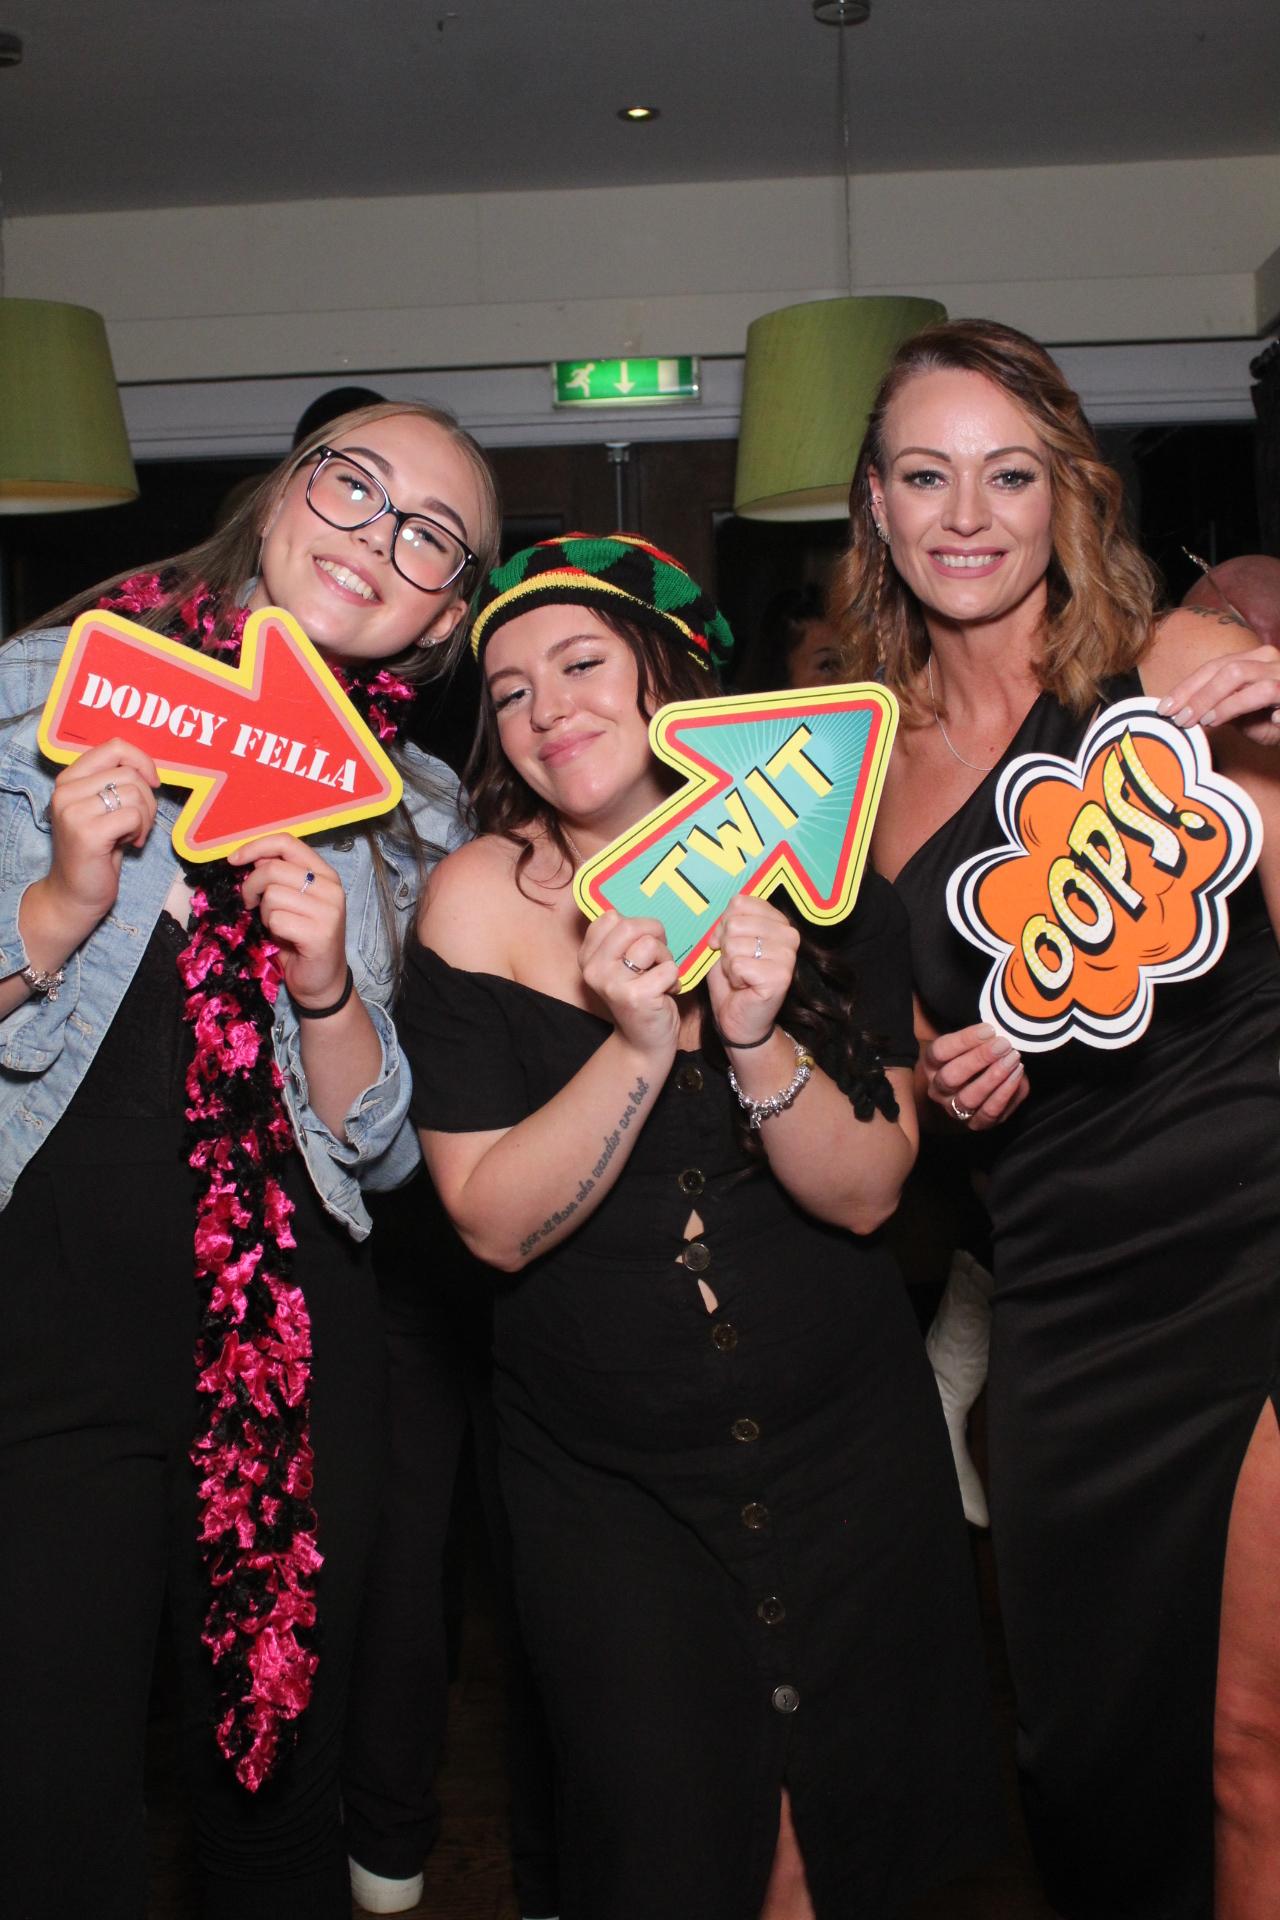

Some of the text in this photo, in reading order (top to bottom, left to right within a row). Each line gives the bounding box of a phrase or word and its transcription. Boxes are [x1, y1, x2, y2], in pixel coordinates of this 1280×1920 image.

[78, 672, 356, 793] DODGY FELLA
[639, 722, 834, 916] TWIT
[1021, 725, 1217, 1001] OOPS!
[551, 1203, 578, 1225] those
[576, 1179, 596, 1202] who
[591, 1129, 621, 1178] wander
[618, 1105, 637, 1130] are
[628, 1076, 650, 1106] lost
